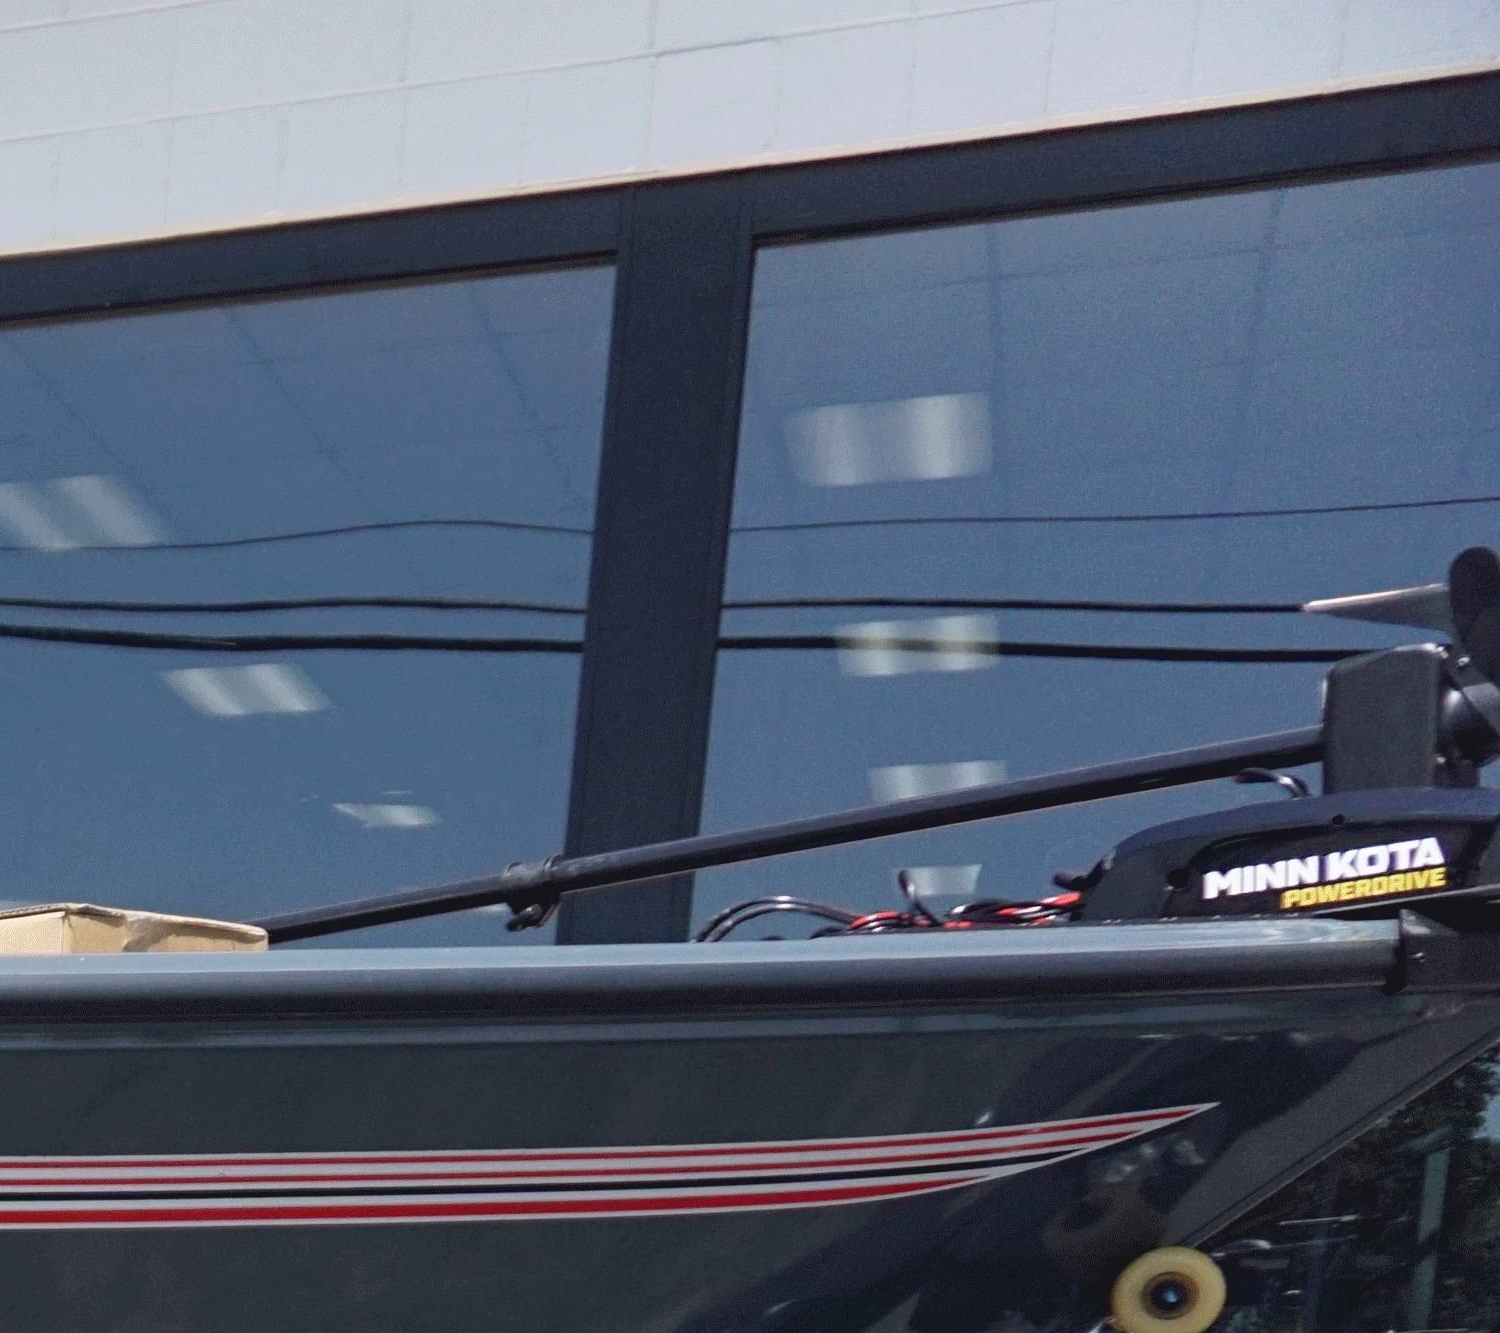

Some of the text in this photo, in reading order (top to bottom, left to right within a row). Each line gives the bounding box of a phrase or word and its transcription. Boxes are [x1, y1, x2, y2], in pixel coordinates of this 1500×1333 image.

[1203, 837, 1445, 900] MINN KOTA
[1280, 867, 1447, 910] POWERDRIVE
